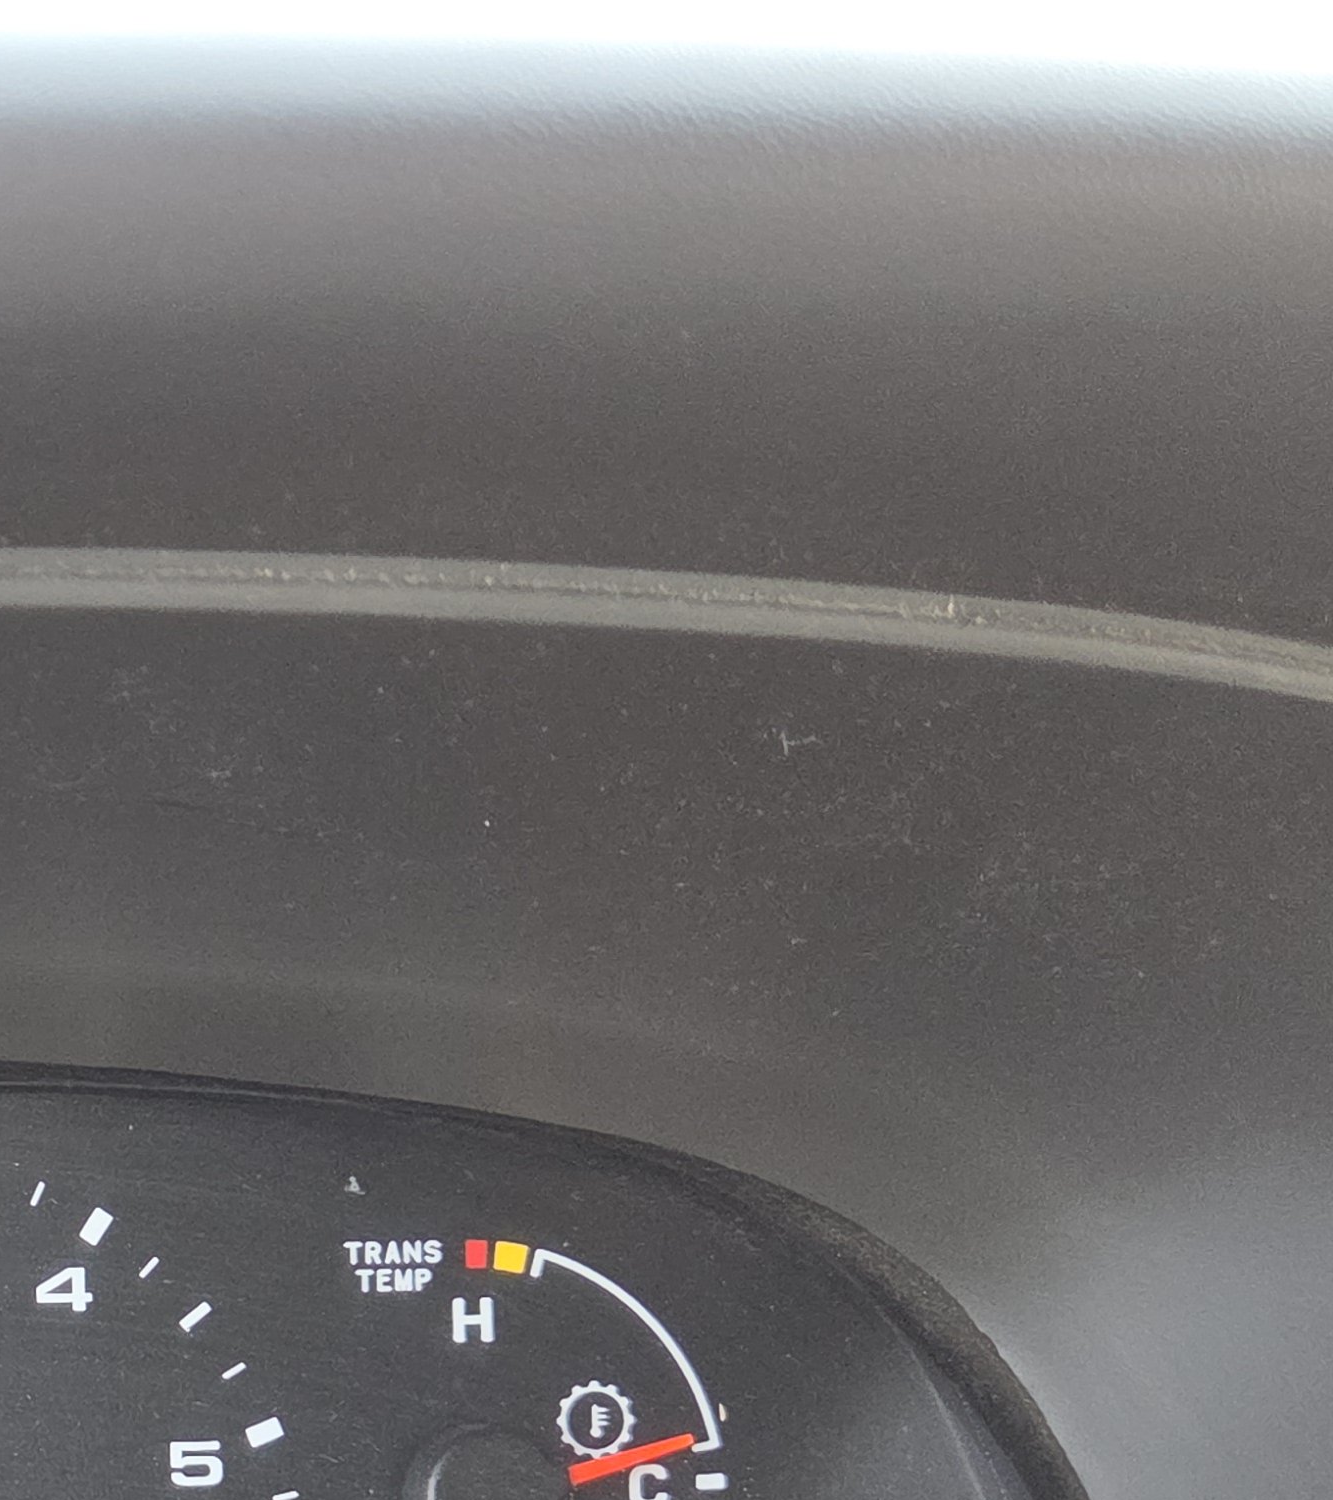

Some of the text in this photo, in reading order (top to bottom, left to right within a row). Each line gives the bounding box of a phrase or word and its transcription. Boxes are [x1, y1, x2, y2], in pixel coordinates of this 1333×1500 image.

[343, 1240, 442, 1265] TRANS
[36, 1267, 93, 1311] 4
[355, 1268, 432, 1292] TEMP
[452, 1297, 494, 1343] H
[170, 1441, 223, 1486] 5
